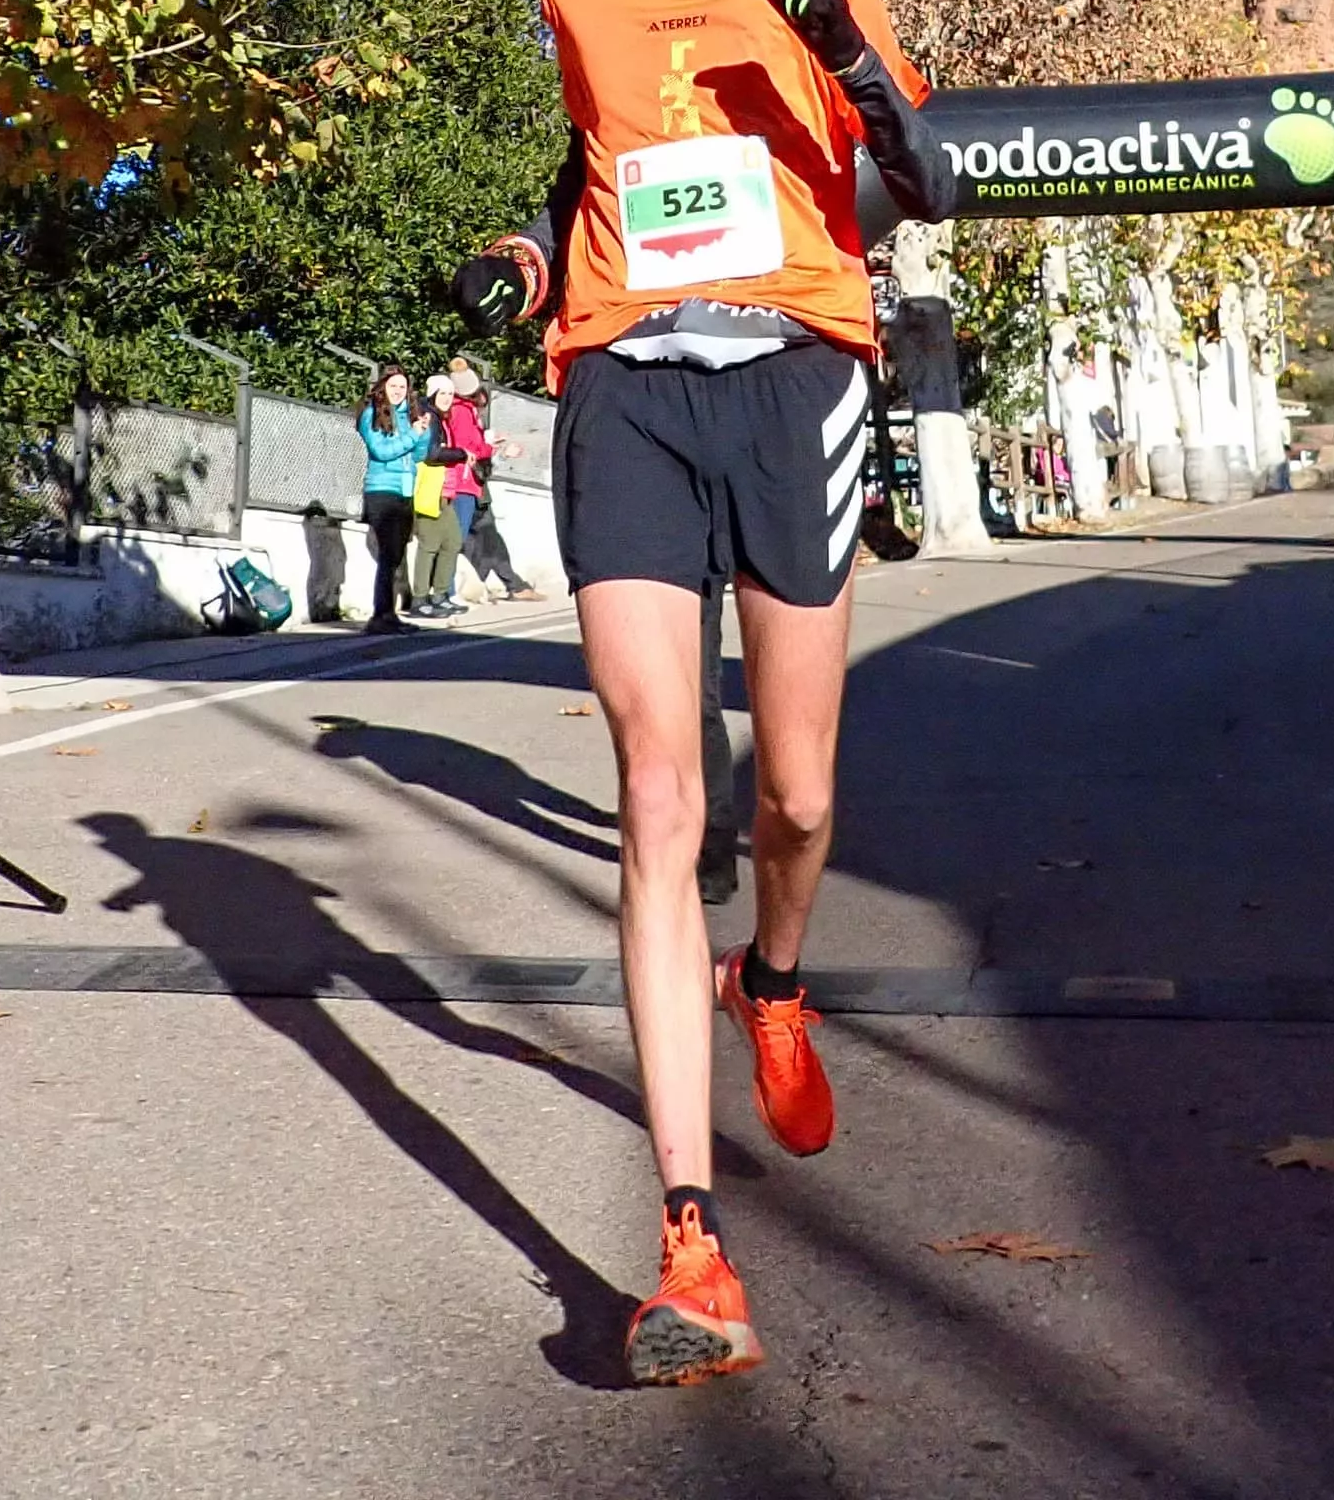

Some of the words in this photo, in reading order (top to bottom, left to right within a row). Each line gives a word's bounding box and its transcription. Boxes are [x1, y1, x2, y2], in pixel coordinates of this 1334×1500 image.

[660, 14, 708, 31] TERREX
[977, 178, 1090, 199] PODOLOGÍA
[1095, 181, 1108, 196] Y
[1114, 173, 1256, 195] BIOMECÁNICA
[662, 181, 728, 218] 523
